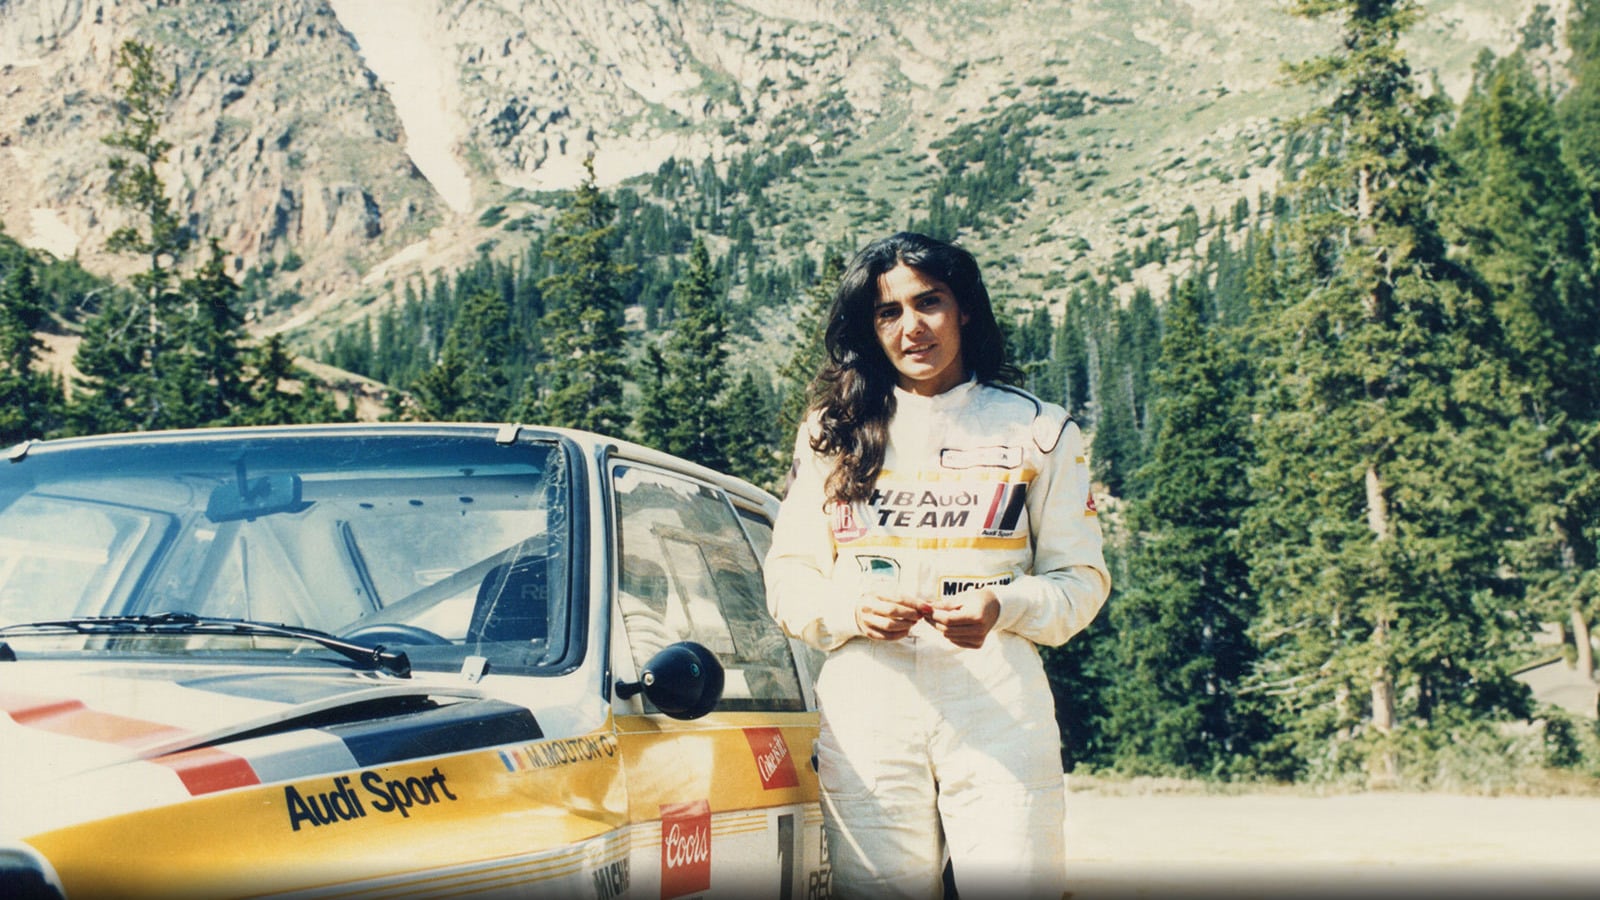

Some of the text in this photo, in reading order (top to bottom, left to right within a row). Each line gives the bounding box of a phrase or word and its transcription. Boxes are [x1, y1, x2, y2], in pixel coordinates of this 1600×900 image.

[877, 508, 970, 528] TEAM
[284, 767, 457, 832] Audi Sport
[665, 823, 708, 869] Coors
